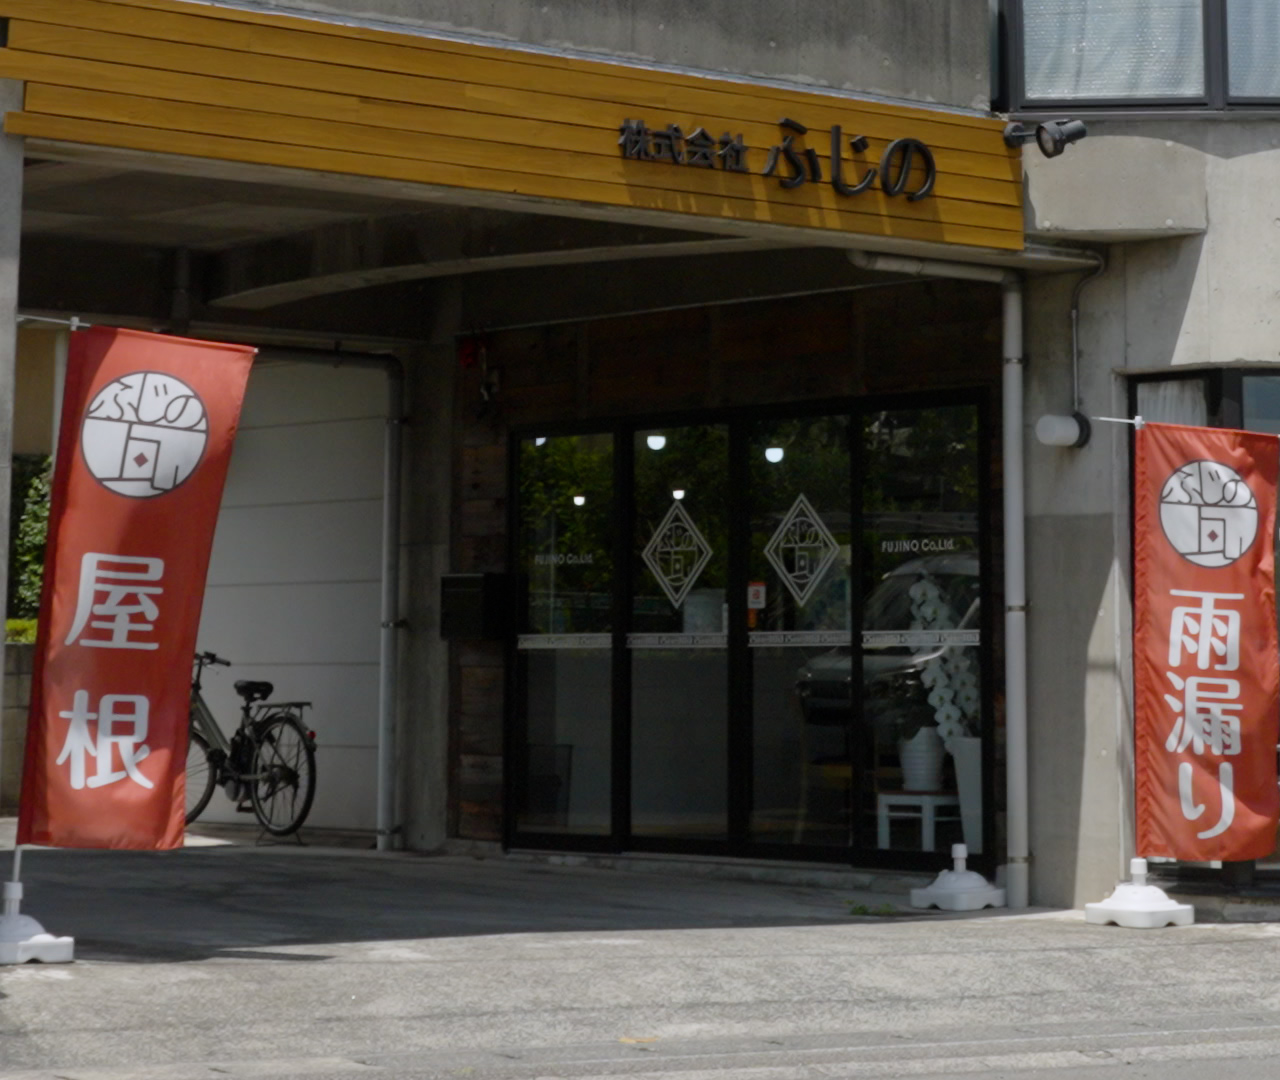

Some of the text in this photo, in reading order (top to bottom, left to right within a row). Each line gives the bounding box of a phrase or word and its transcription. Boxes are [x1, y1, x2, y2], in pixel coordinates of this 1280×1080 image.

[881, 539, 919, 553] FUJINO
[55, 551, 166, 791] 屋根
[1163, 588, 1245, 840] 雨漏り
